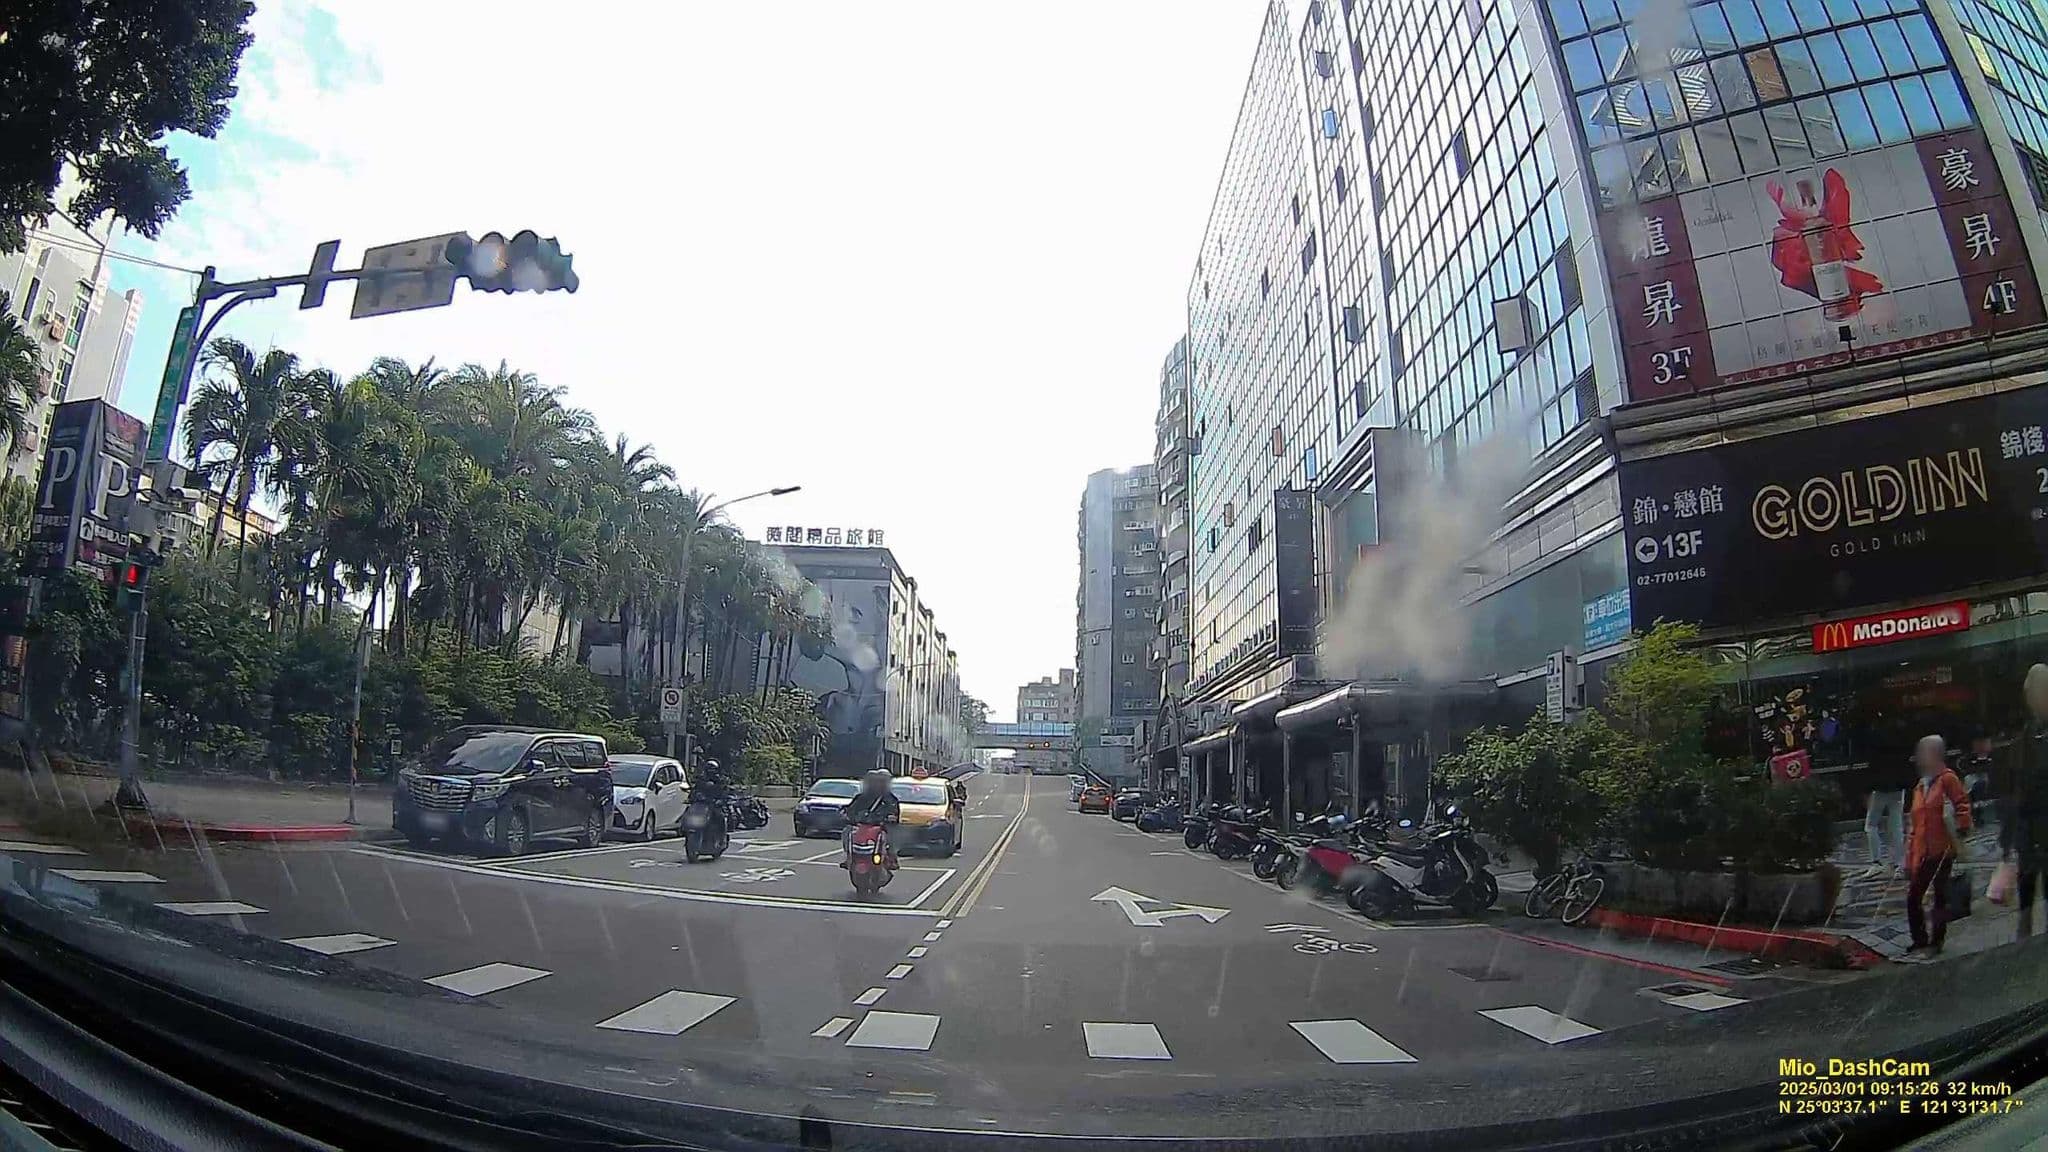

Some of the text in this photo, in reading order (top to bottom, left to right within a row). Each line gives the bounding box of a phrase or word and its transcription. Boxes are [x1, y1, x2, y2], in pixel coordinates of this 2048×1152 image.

[1935, 147, 2001, 260] 豪昇
[1982, 277, 2018, 315] 4F
[1651, 346, 1691, 384] 3F
[41, 446, 77, 510] P
[91, 451, 131, 520] P
[1661, 530, 1702, 559] 13F
[1830, 528, 1928, 558] GOLD INN
[1637, 568, 1706, 586] 02-77012646
[1853, 610, 1960, 642] McDonalds
